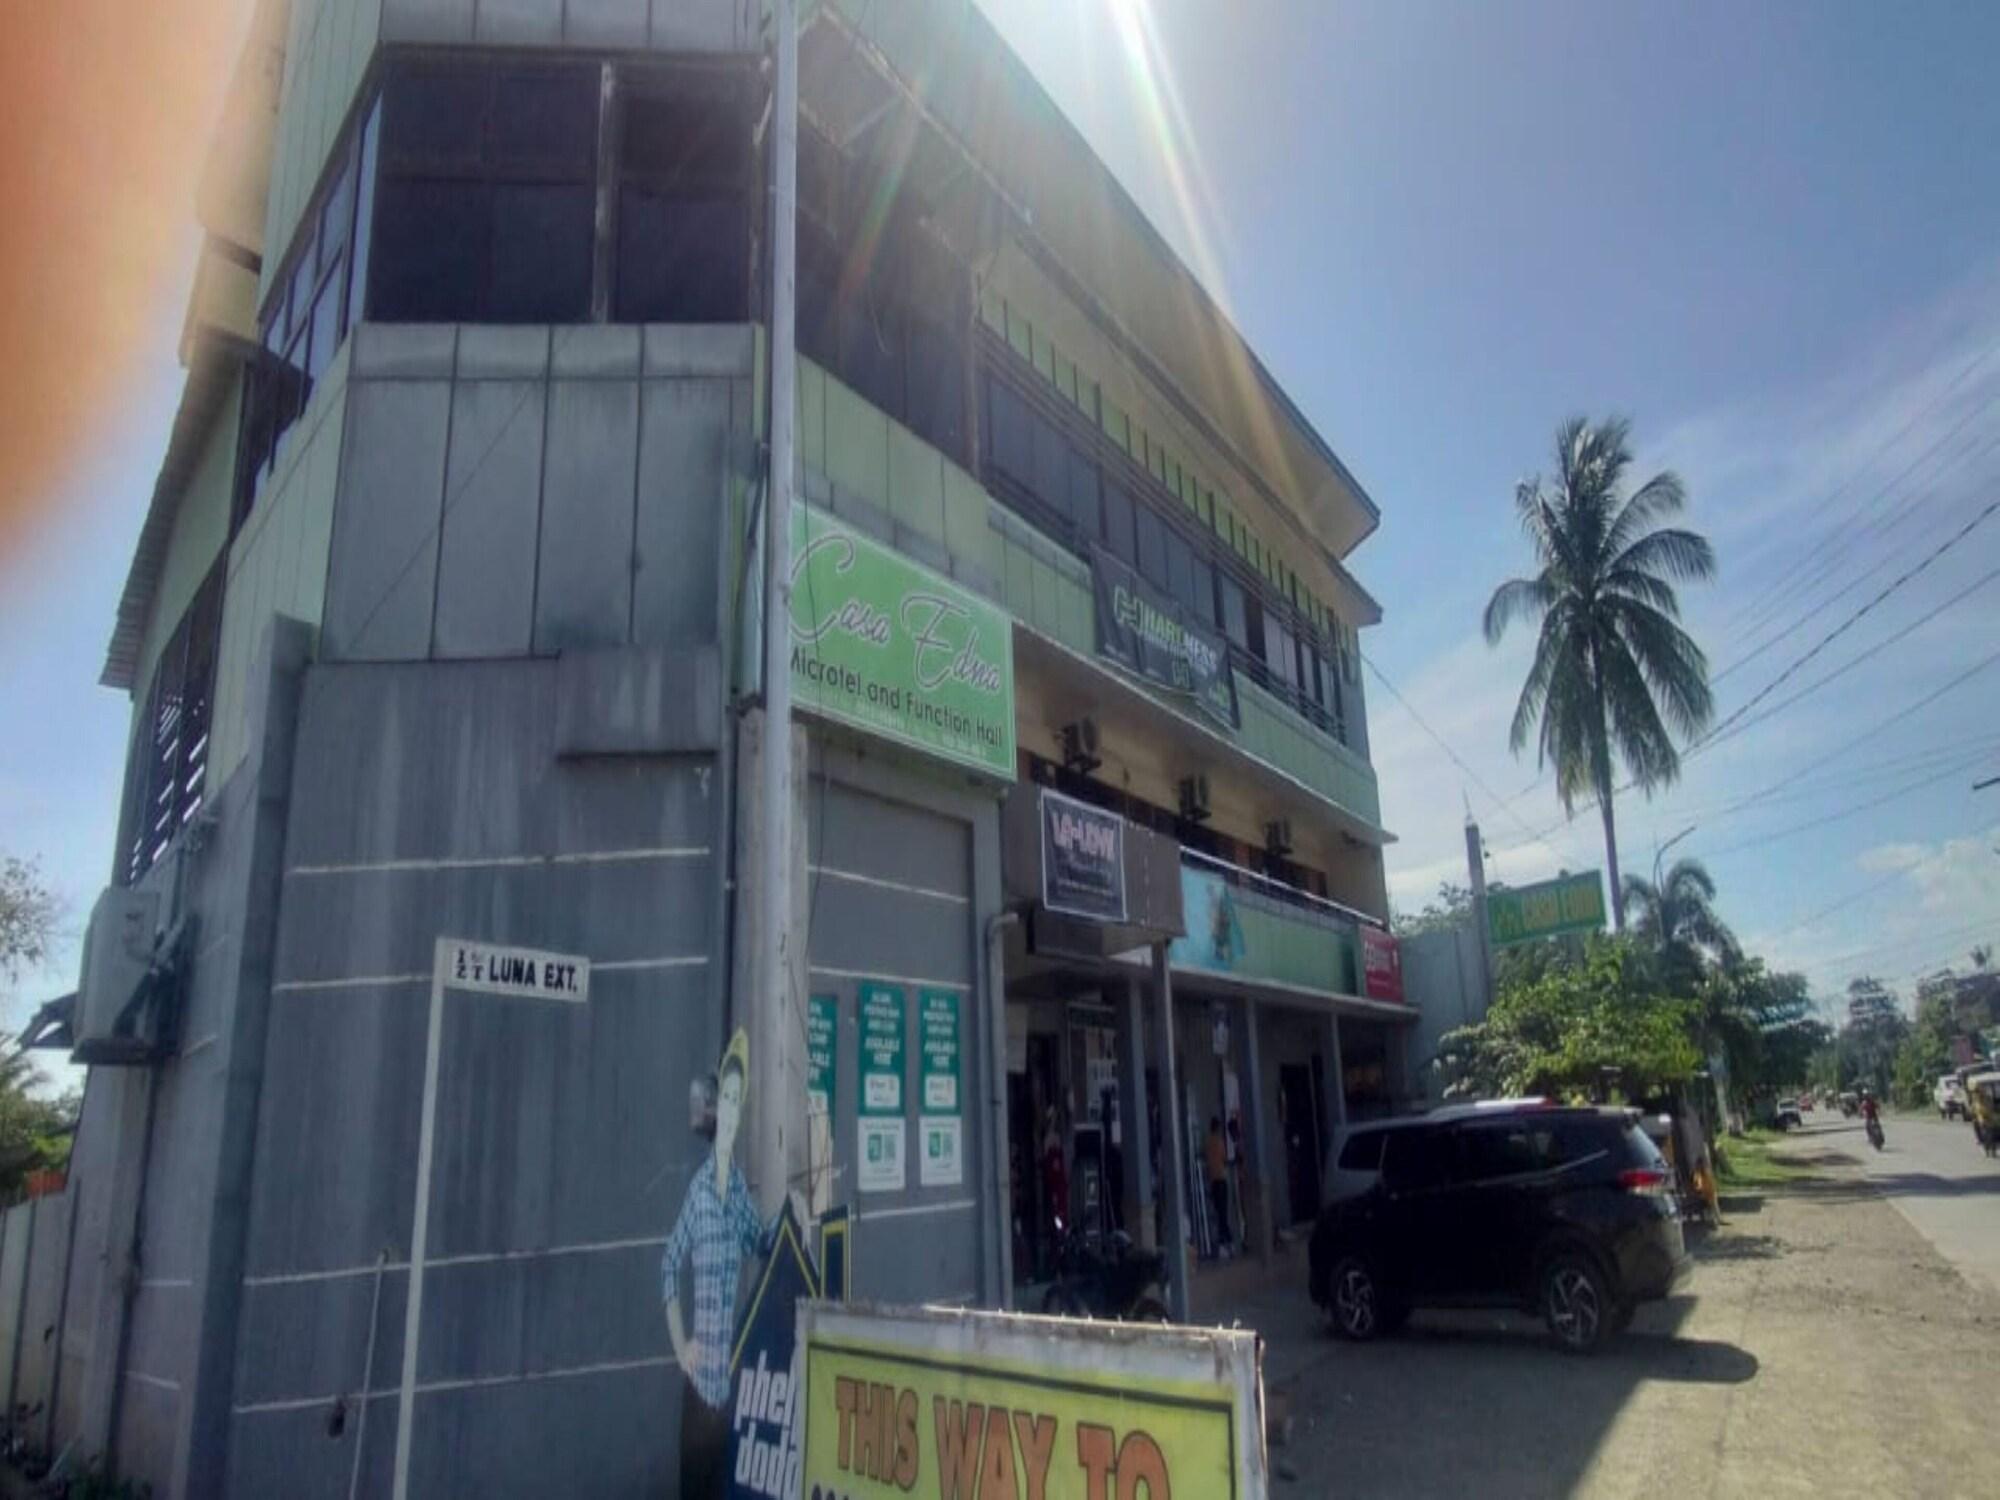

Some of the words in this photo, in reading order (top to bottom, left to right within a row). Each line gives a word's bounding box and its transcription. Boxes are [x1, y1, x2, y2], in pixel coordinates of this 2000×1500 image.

[867, 682, 900, 710] and
[905, 691, 971, 733] Function
[976, 718, 1002, 748] Hall
[488, 954, 537, 987] LUNA
[543, 961, 578, 993] EXT.
[733, 1349, 800, 1446] phel
[836, 1375, 920, 1494] THIS
[932, 1395, 1058, 1500] WAY
[1076, 1421, 1172, 1500] TO
